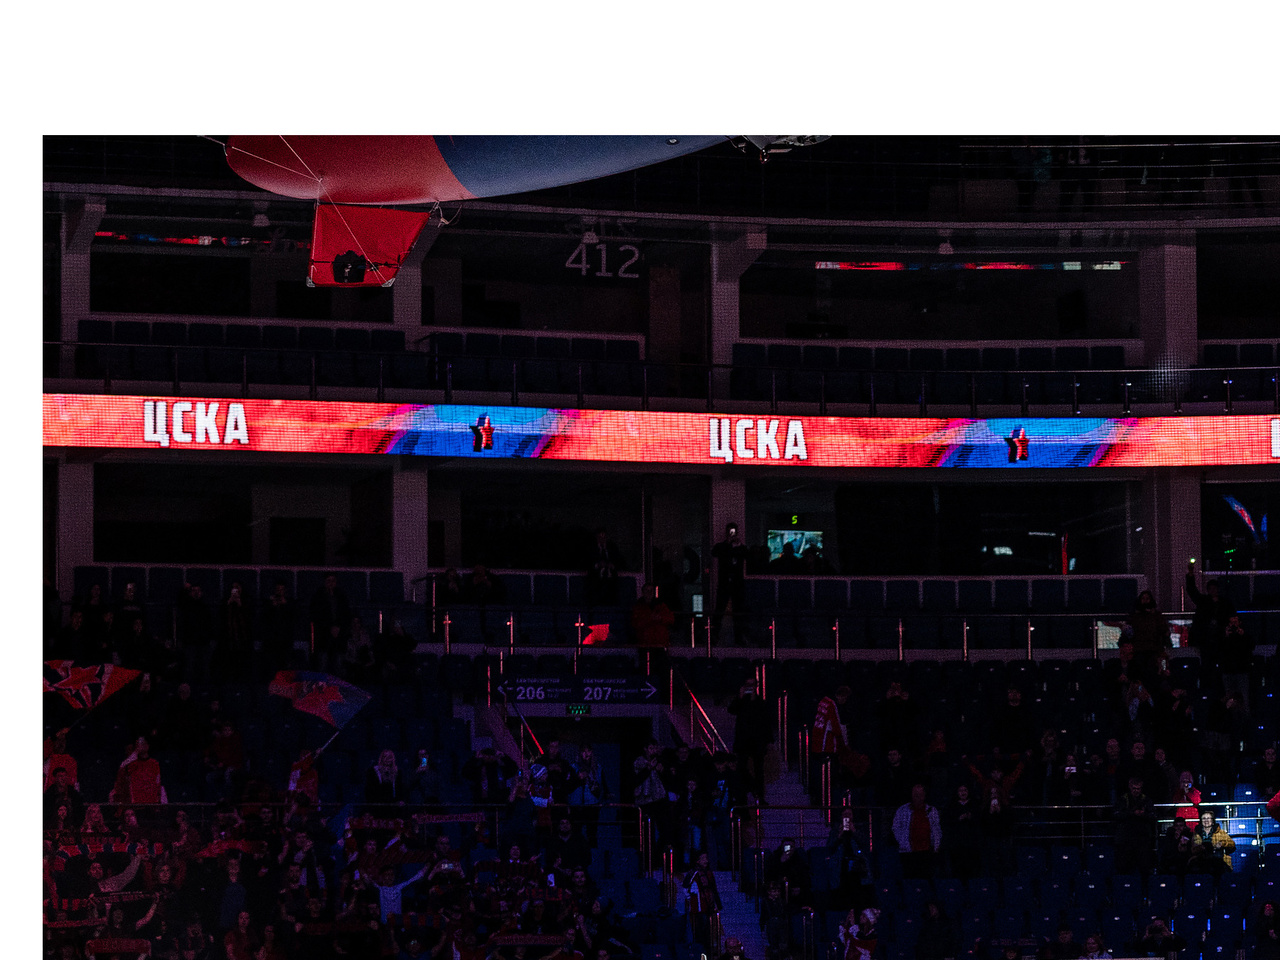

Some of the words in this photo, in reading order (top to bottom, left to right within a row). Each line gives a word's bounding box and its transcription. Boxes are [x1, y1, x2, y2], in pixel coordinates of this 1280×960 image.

[565, 243, 639, 278] 412
[143, 400, 249, 446] ЦСКА
[708, 418, 808, 463] ЦСКА
[516, 686, 545, 700] 206
[583, 686, 612, 701] 207
